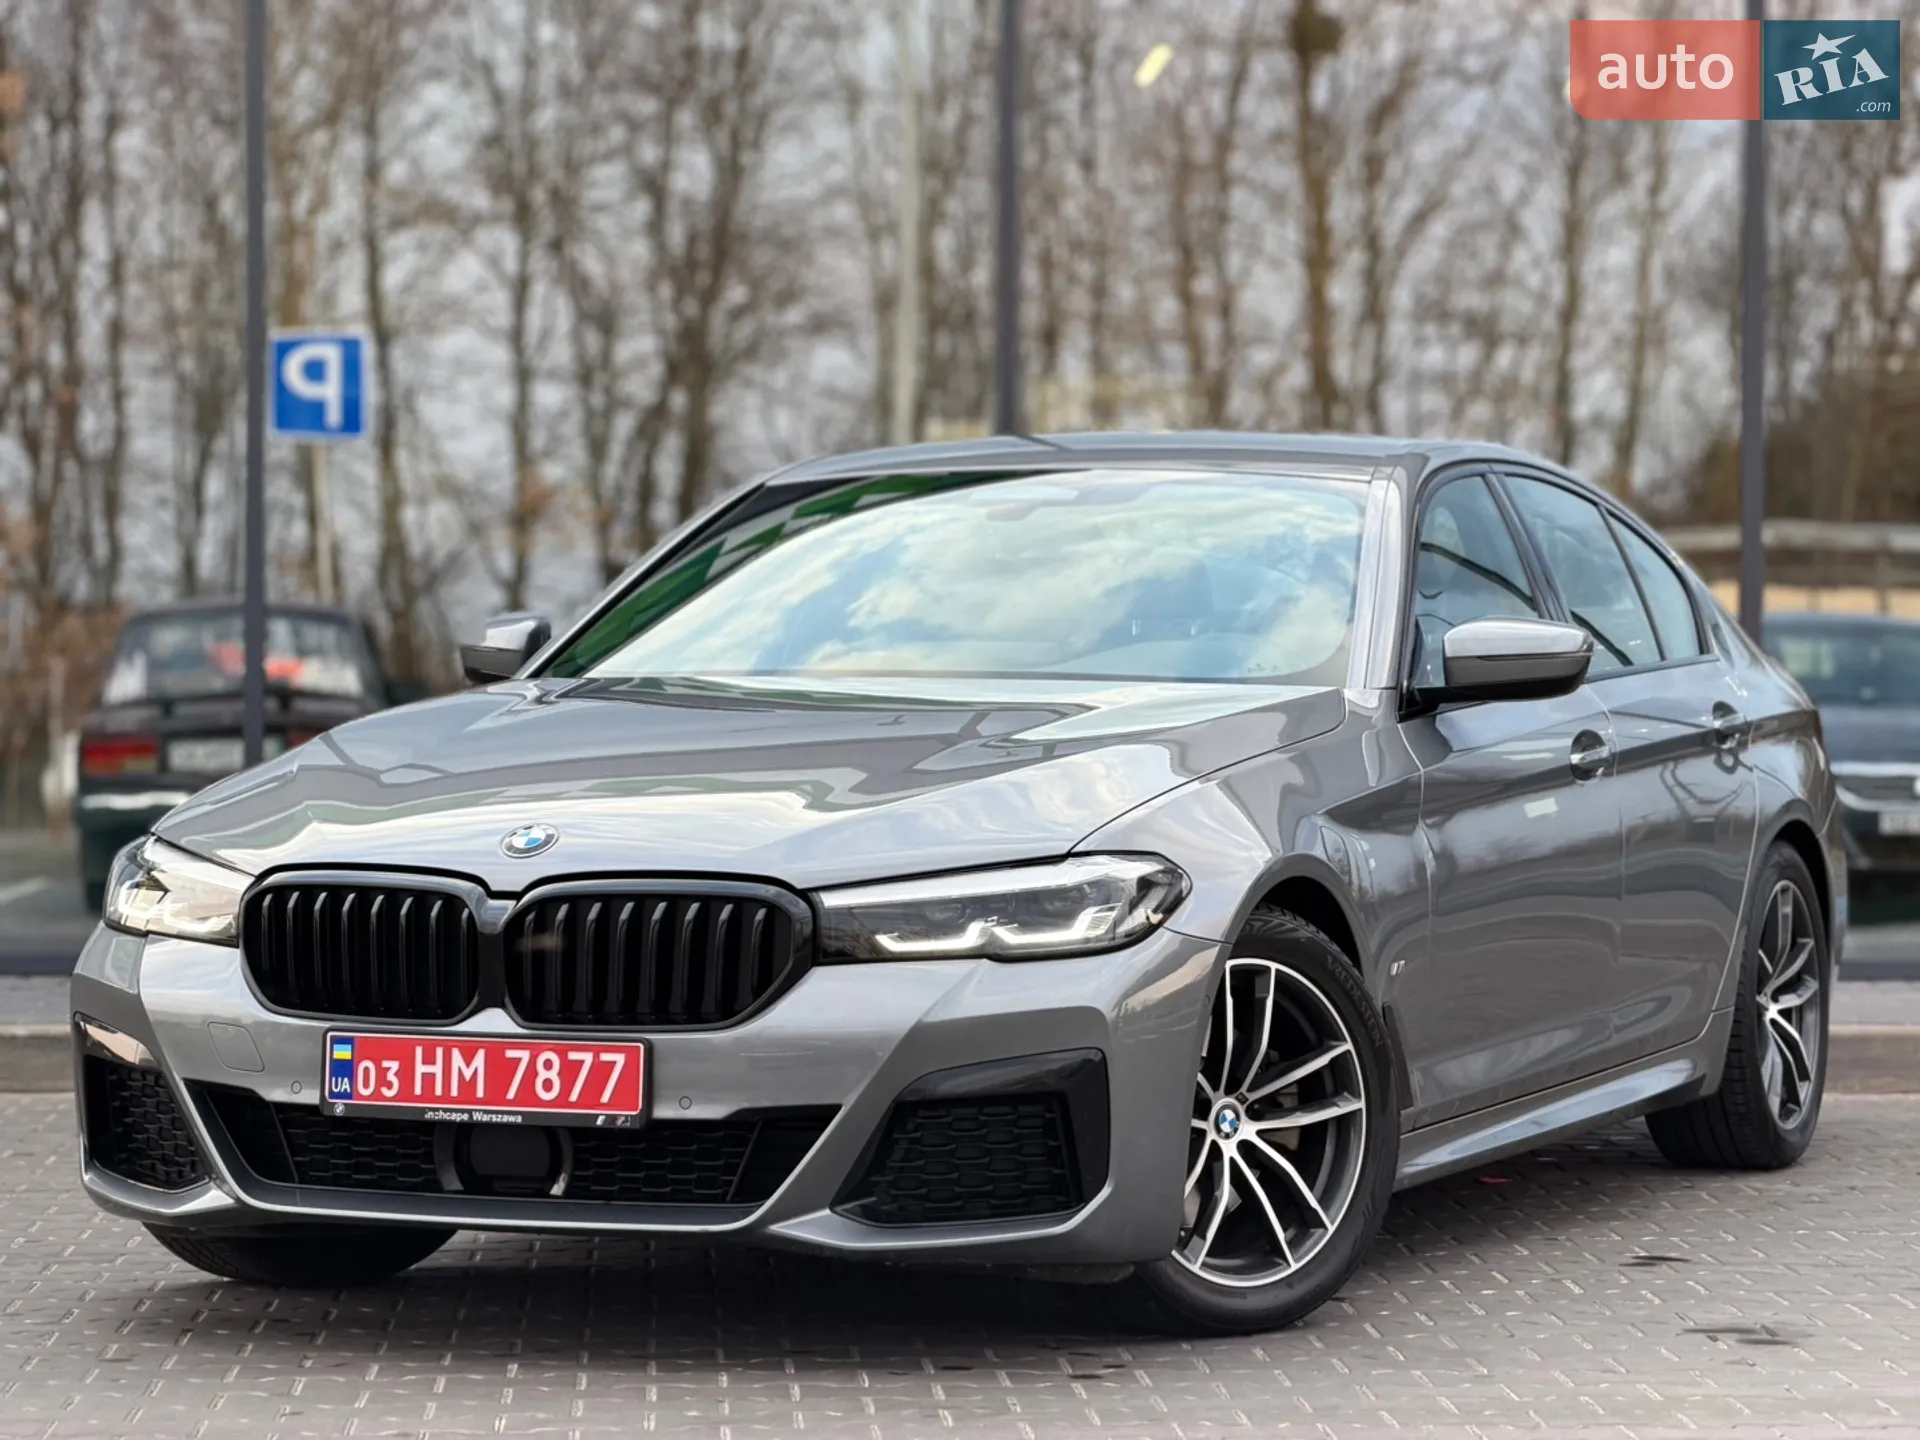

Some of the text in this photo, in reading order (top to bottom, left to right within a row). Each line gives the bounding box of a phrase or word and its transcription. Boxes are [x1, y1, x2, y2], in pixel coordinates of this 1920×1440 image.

[331, 1075, 351, 1093] UA
[357, 1046, 626, 1104] 03 HM 7877
[472, 1106, 522, 1123] Warszawa
